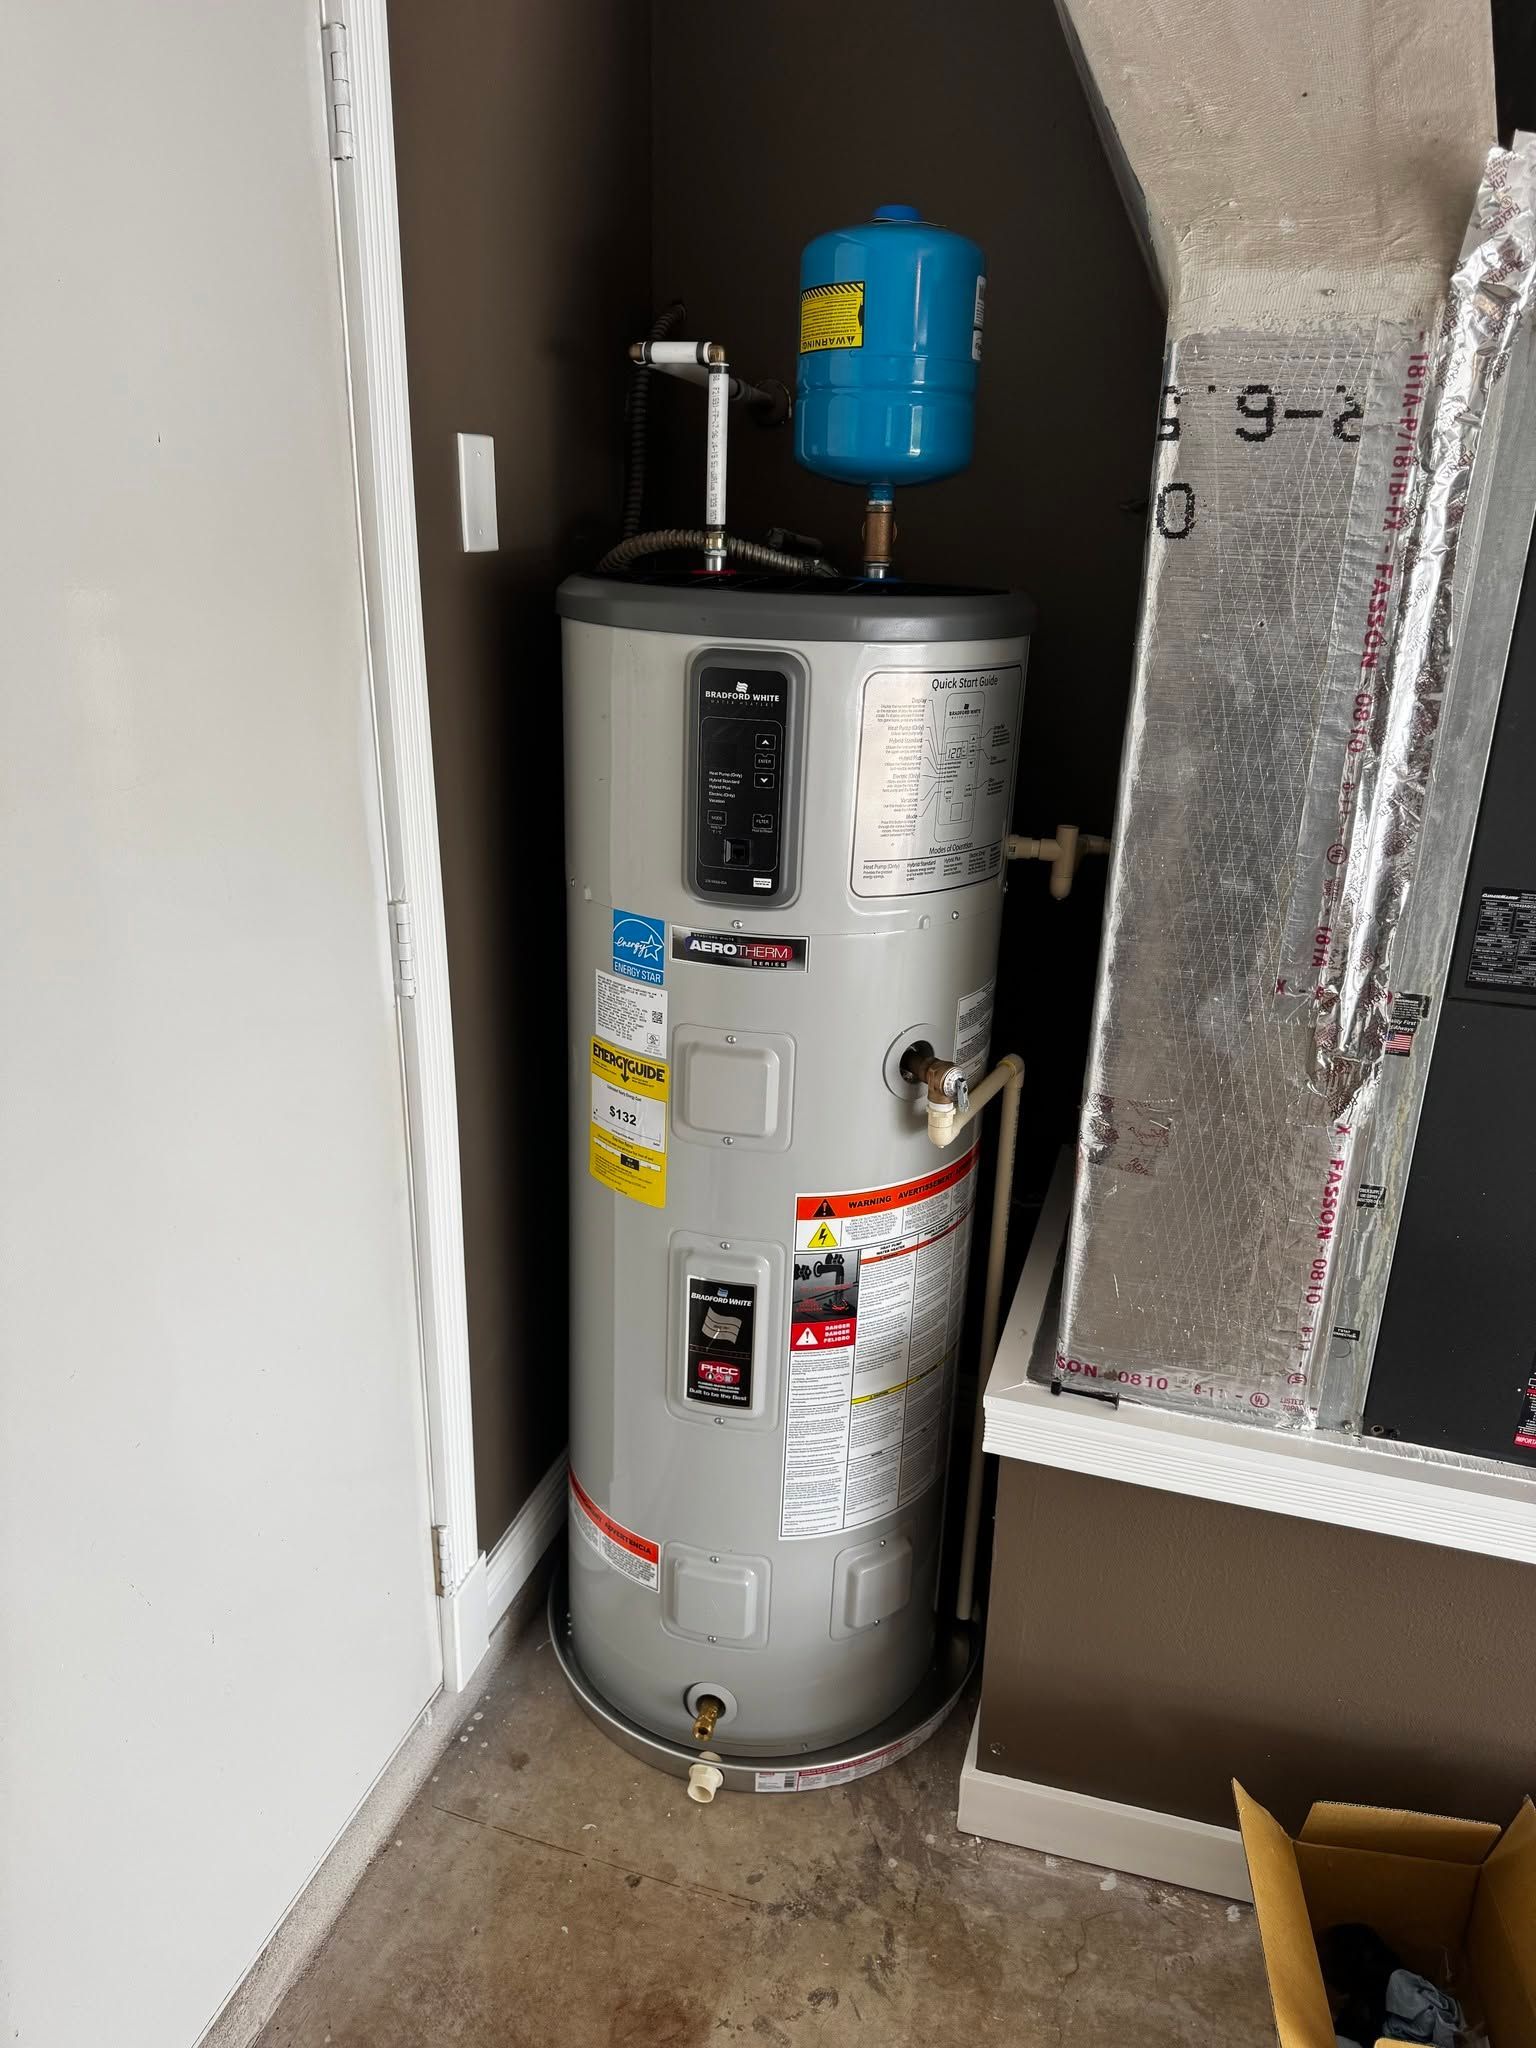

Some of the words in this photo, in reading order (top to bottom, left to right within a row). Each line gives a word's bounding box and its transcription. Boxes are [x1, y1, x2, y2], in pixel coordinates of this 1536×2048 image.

[802, 336, 846, 350] WARNING
[1360, 564, 1393, 668] FASSON
[932, 678, 957, 691] Quick
[959, 677, 978, 689] Start
[979, 676, 999, 687] Guide
[705, 690, 751, 700] BRADFORD
[752, 694, 780, 702] WHITE
[1348, 693, 1373, 752] 0810
[948, 747, 962, 759] 120
[929, 846, 946, 855] Modes
[953, 842, 973, 851] Operation
[615, 936, 650, 958] energy
[690, 939, 788, 959] AEROTHERM
[1312, 926, 1332, 968] 181A
[614, 961, 641, 978] ENERGY
[641, 970, 661, 984] STAR
[753, 960, 785, 968] SERIES
[593, 1042, 666, 1083] ENERGYGUIDE
[609, 1105, 637, 1127] $132
[848, 1195, 892, 1209] WARNING
[898, 1174, 952, 1200] AVERTISSEMENT
[1316, 1158, 1345, 1240] FASSON
[1306, 1258, 1328, 1305] 0810
[690, 1292, 728, 1304] BRADFORD
[728, 1298, 752, 1307] WHITE
[824, 1323, 850, 1331] DANGER
[824, 1329, 850, 1337] DANGER
[823, 1335, 850, 1343] PELIGRO
[701, 1363, 739, 1376] PHCC
[1117, 1371, 1169, 1391] 0810
